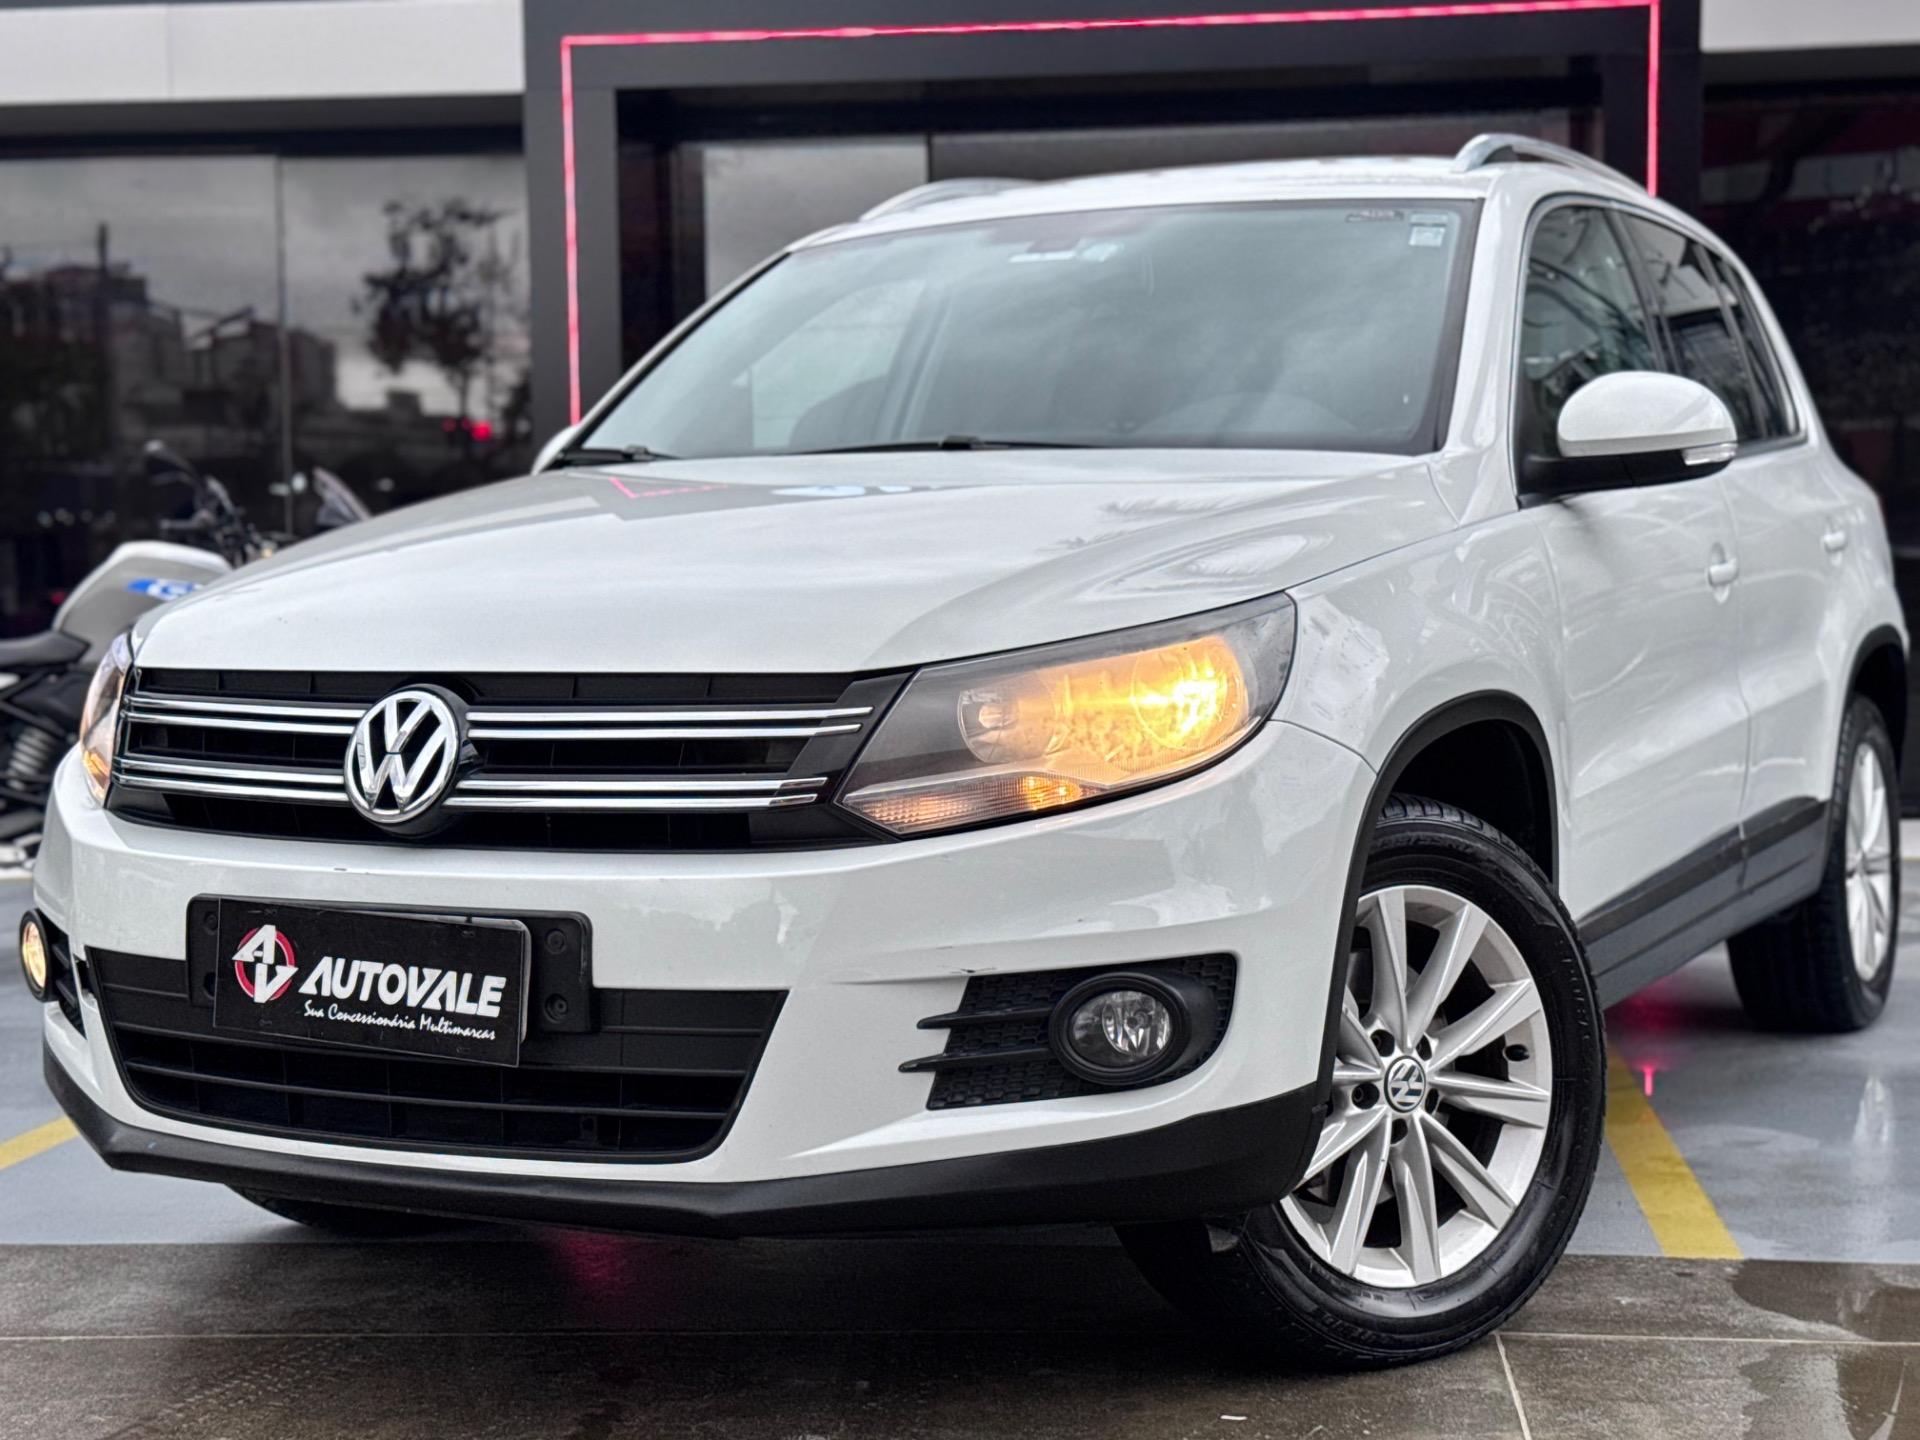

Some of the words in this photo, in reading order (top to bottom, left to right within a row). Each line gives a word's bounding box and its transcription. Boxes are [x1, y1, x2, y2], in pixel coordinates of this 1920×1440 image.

[347, 691, 458, 820] VW
[298, 956, 506, 1018] AUTOVALE
[303, 999, 325, 1017] Sua
[327, 1003, 416, 1029] Concessionária
[418, 1013, 496, 1041] Multimarcas
